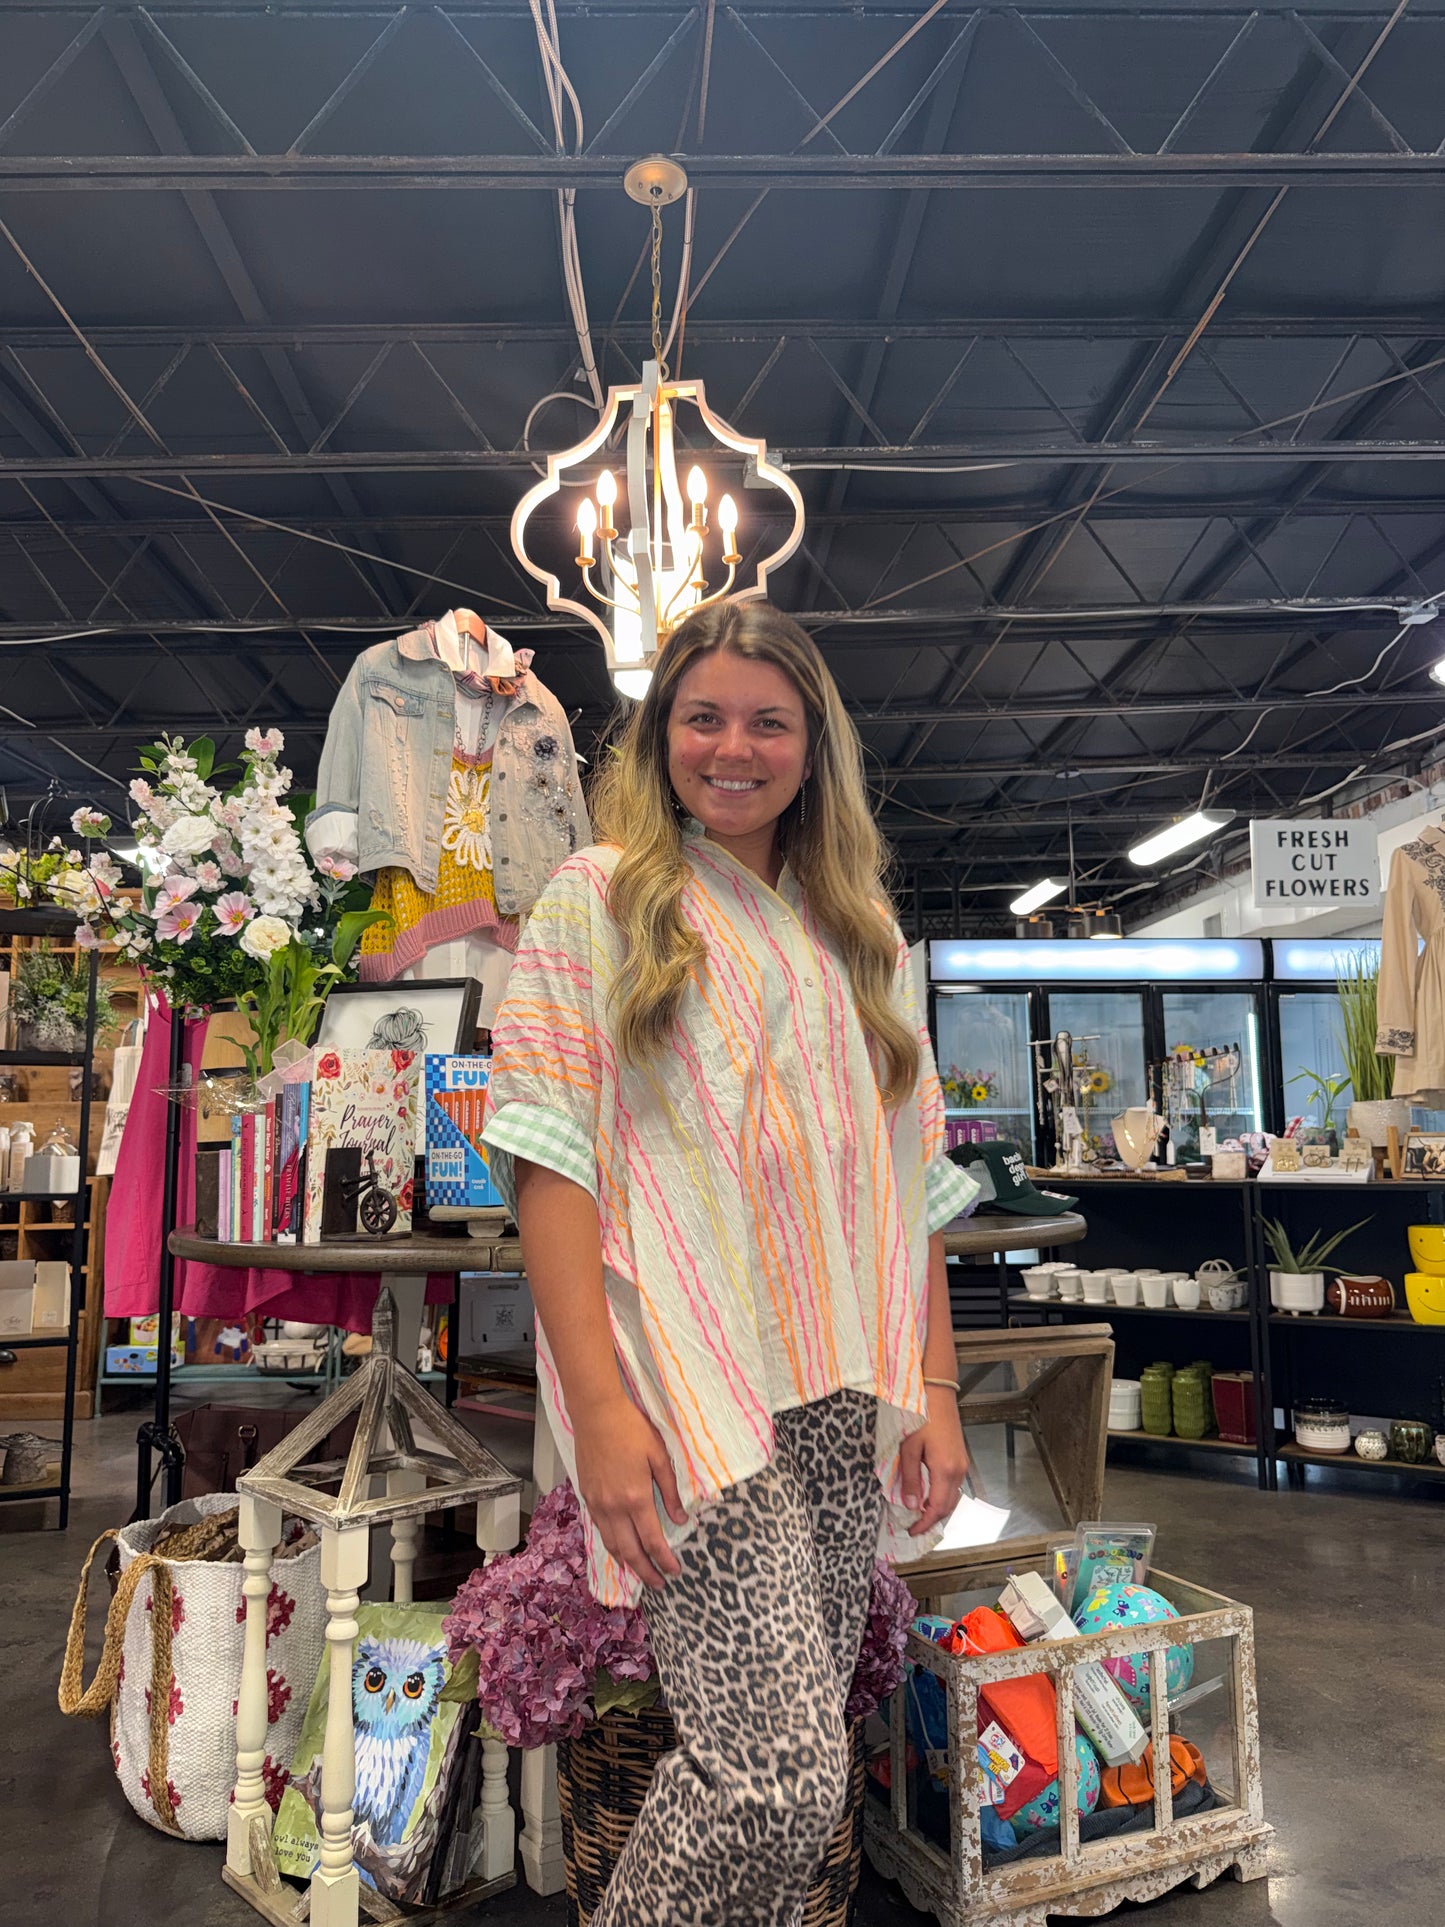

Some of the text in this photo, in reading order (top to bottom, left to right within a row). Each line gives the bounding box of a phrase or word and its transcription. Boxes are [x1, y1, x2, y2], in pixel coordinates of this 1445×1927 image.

[1277, 830, 1348, 848] FRESH
[1291, 853, 1337, 871] CUT
[1266, 879, 1369, 897] FLOWERS
[452, 1060, 492, 1069] ON-THE-G
[452, 1070, 490, 1086] FUN
[340, 1104, 393, 1141] Prayer
[339, 1125, 396, 1155] Journal
[431, 1152, 463, 1160] ON-THE-GO
[431, 1161, 463, 1178] FUN!
[274, 1834, 319, 1851] owl always
[275, 1846, 311, 1862] love you
